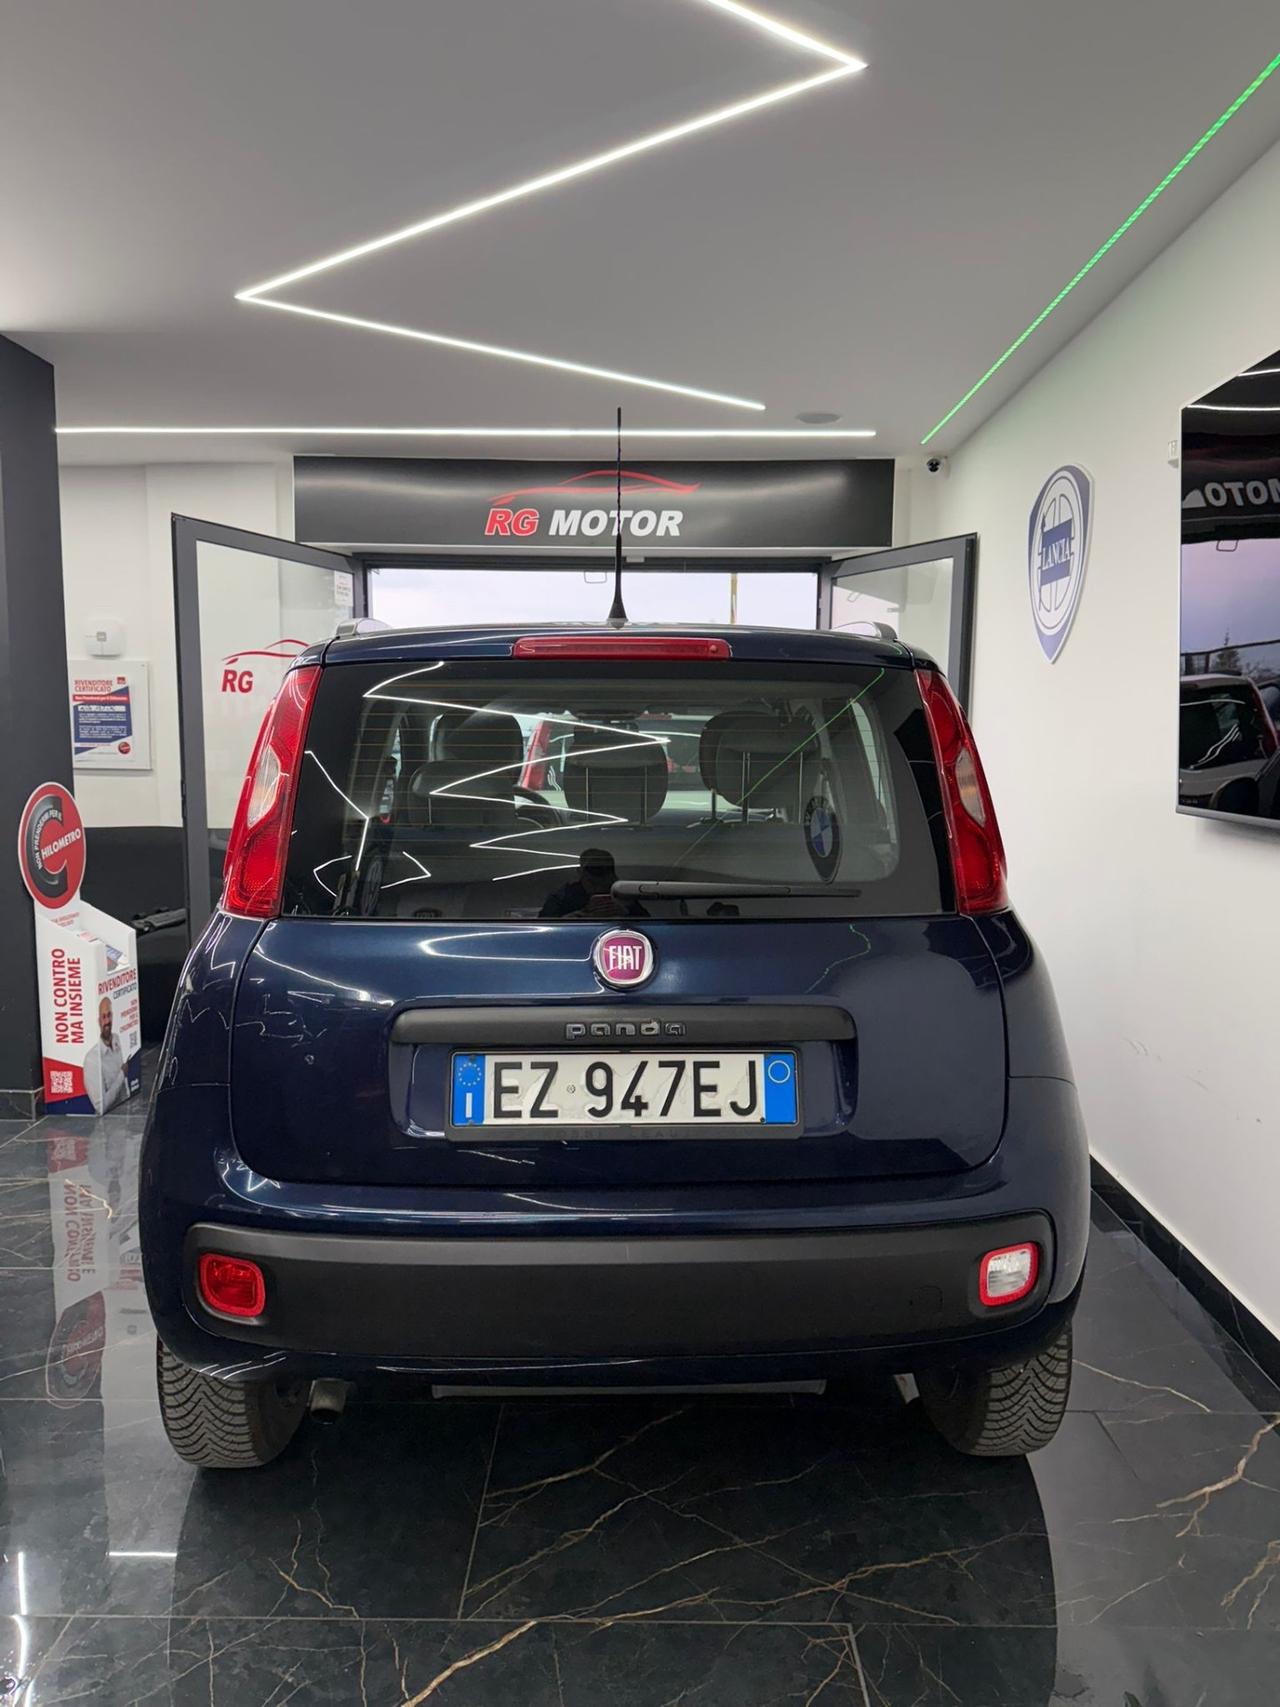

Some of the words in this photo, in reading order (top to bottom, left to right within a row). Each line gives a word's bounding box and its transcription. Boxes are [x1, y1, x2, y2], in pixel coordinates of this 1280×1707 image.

[484, 508, 540, 536] RG
[548, 509, 684, 537] MOTOR
[221, 669, 254, 694] RG
[609, 945, 642, 970] FIAT
[51, 948, 67, 1007] CONTRO
[67, 957, 83, 1017] INSIEME
[98, 968, 137, 995] RIVENDITORE
[55, 1011, 69, 1043] NON
[70, 1020, 84, 1044] MA
[565, 1020, 687, 1040] panda
[493, 1061, 559, 1118] EZ
[584, 1060, 757, 1118] 947EJ
